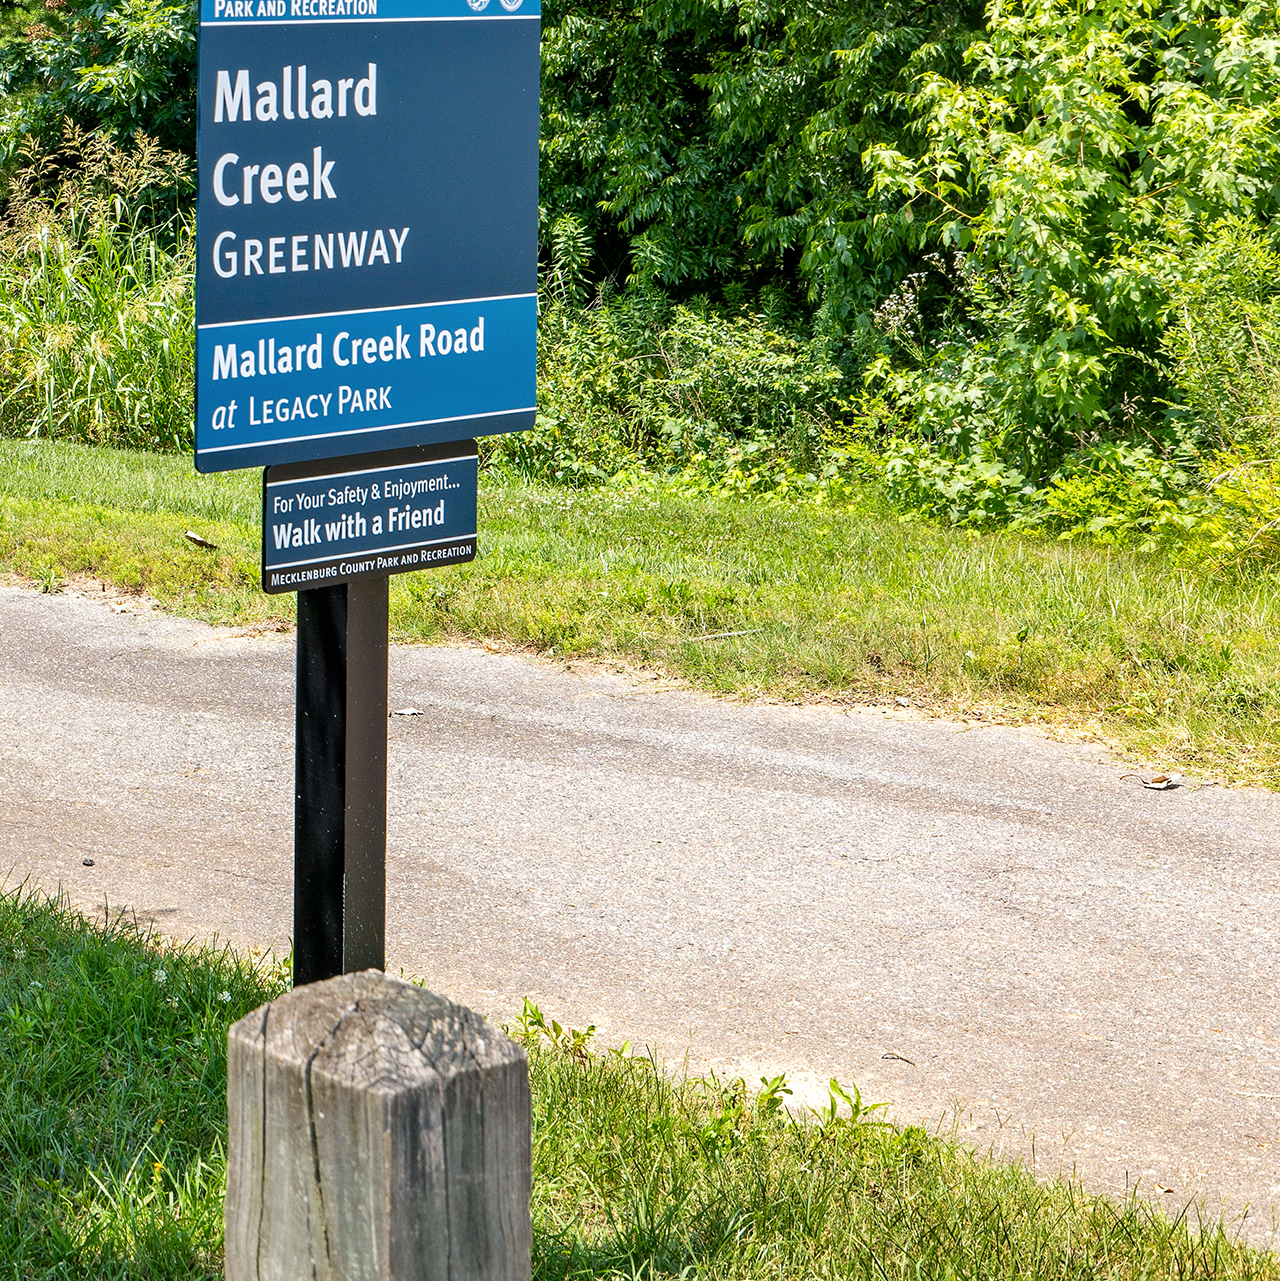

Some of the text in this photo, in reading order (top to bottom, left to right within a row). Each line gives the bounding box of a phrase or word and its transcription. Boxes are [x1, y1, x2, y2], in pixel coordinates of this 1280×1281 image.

[257, 0, 286, 17] AND
[214, 62, 377, 123] Mallard
[212, 146, 337, 207] Creek
[212, 227, 410, 278] GREENWAY
[212, 316, 485, 380] Mallard Creek Road
[211, 385, 392, 430] at LEGACY PARK
[273, 473, 460, 514] For Your Safety & Enjoyment...
[272, 499, 445, 550] Walk with a Friend
[271, 545, 472, 587] MECKLENBURG COUNTY PARK AND RECREATION
